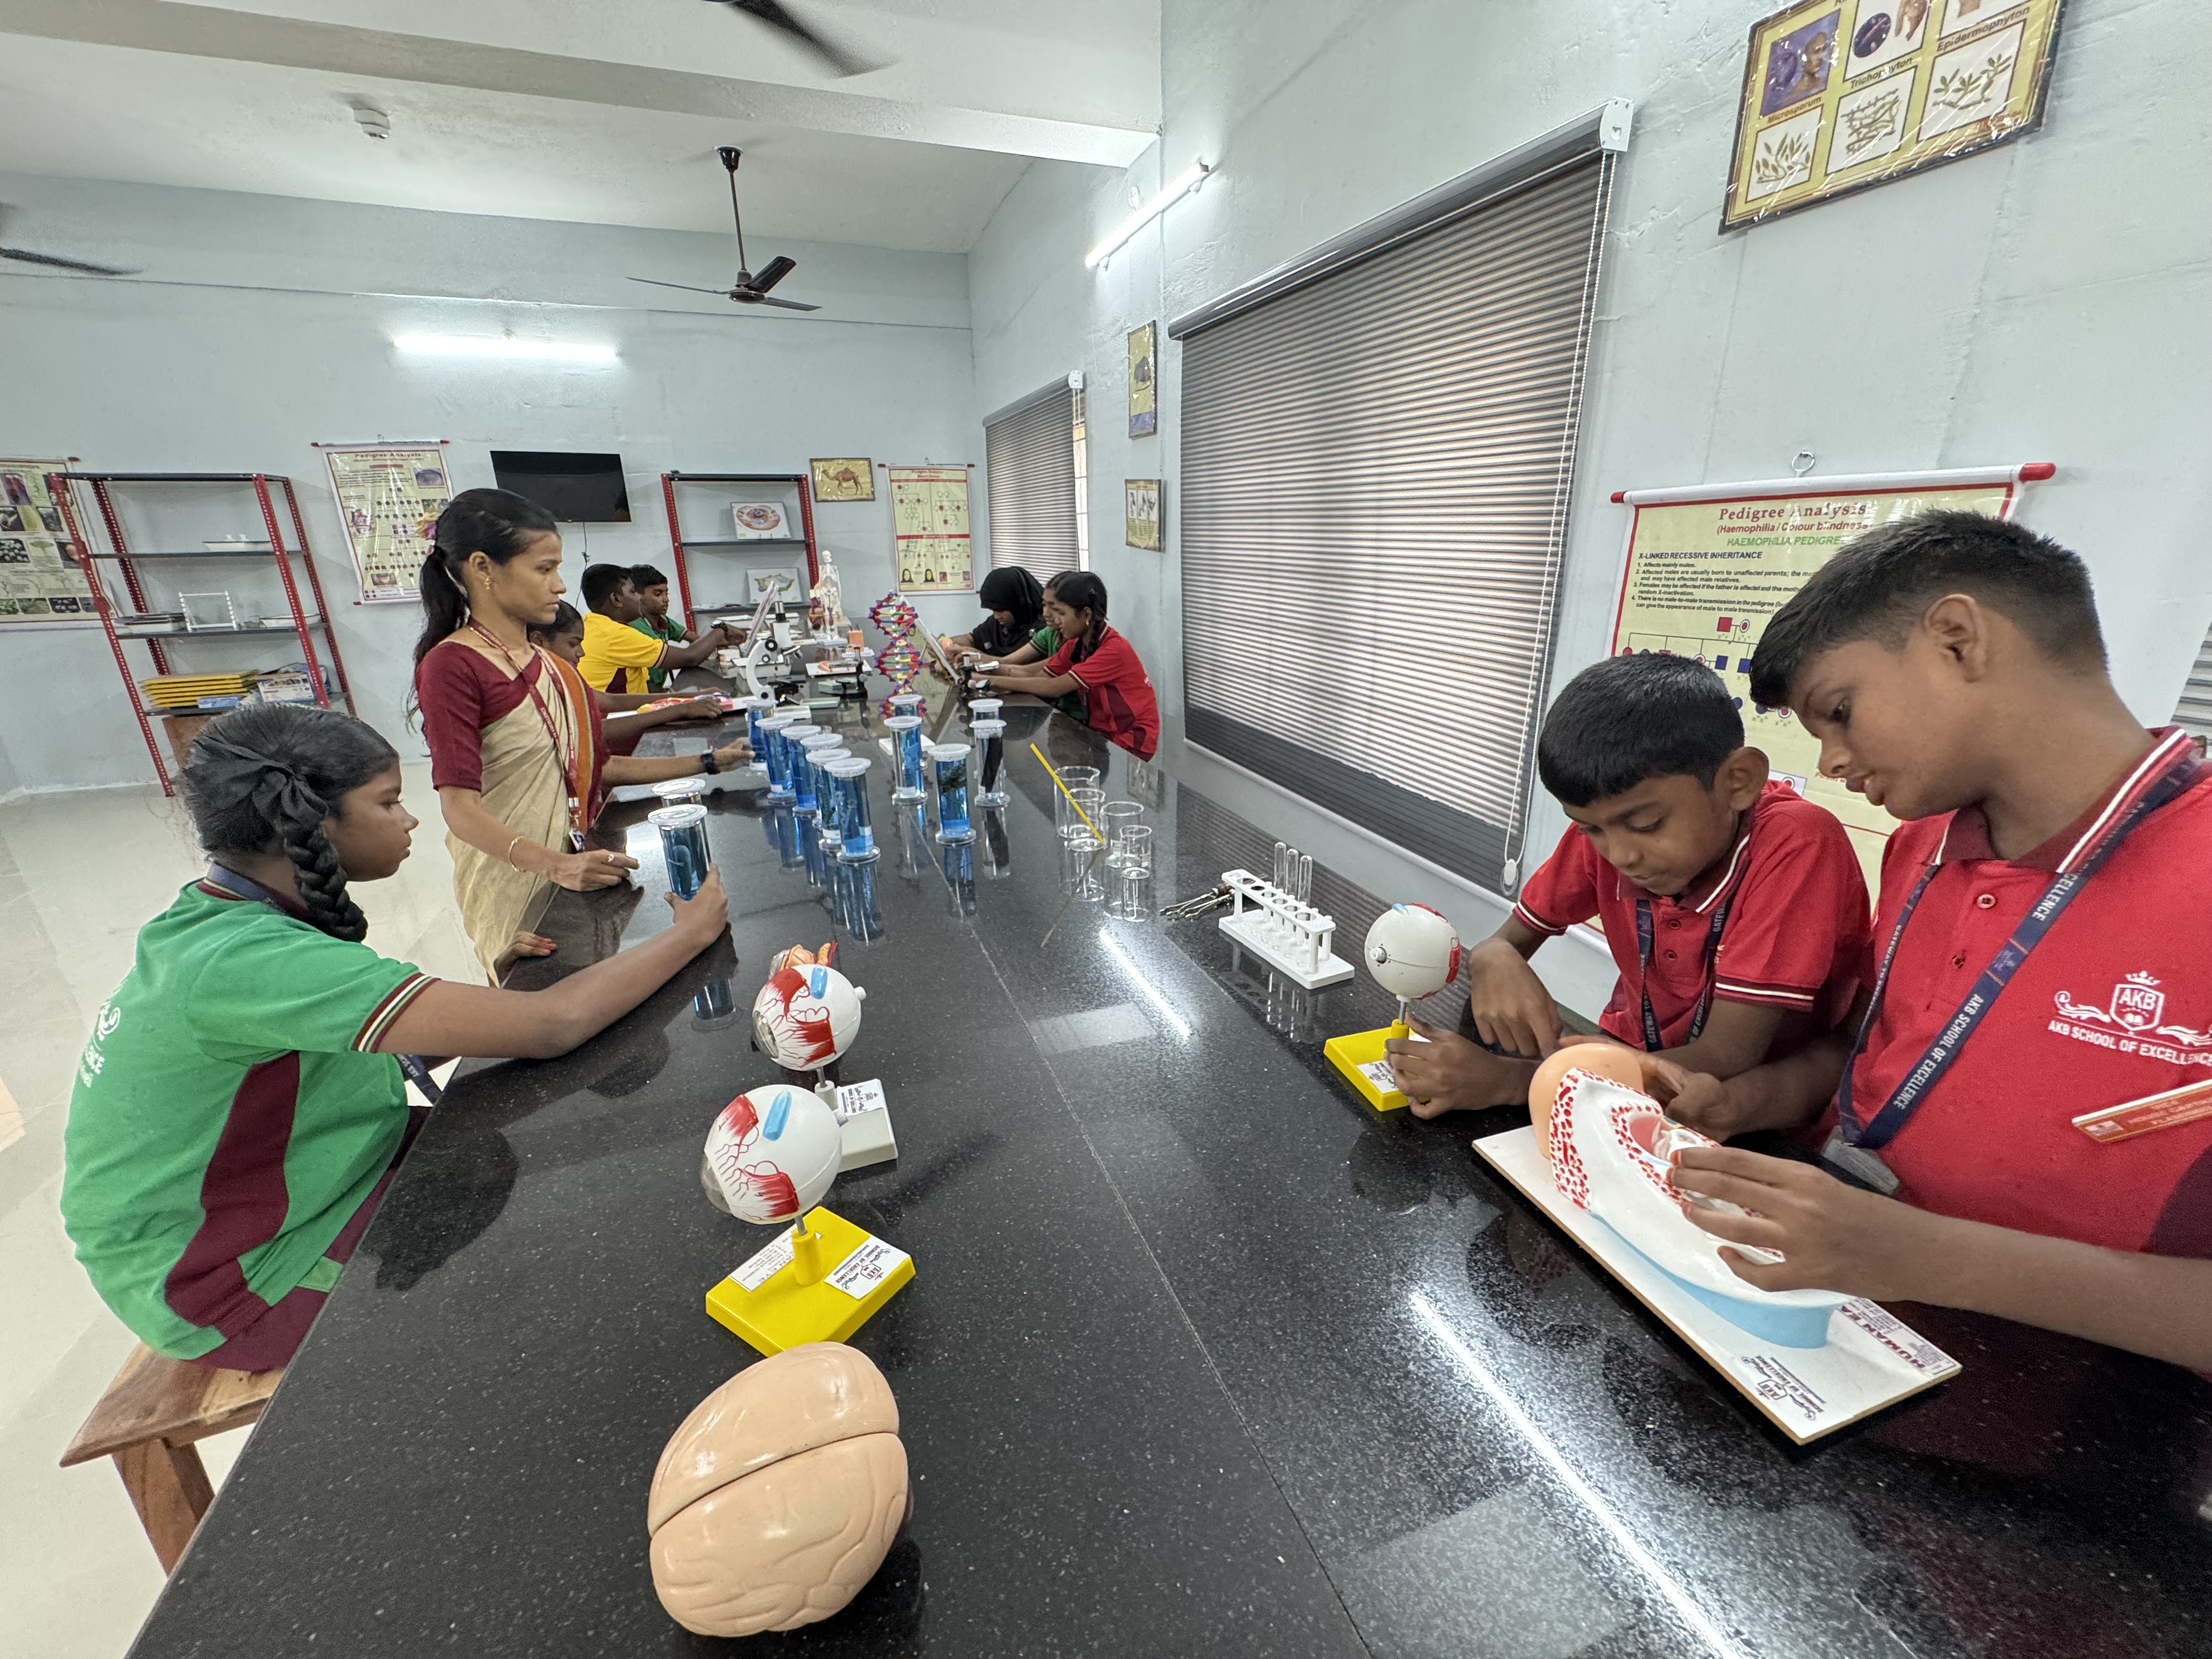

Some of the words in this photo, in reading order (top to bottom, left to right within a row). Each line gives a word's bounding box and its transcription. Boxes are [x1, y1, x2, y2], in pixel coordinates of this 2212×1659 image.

[1768, 97, 1821, 123] Microsporum
[1718, 507, 1785, 522] Pedigree
[1717, 522, 1775, 535] (Haemophilia
[1726, 535, 1793, 546] HAEMOPHILIA
[1793, 536, 1844, 545] PEDIGRE
[2032, 872, 2079, 922] CELLENCE
[1884, 925, 1902, 964] GATEWAY
[1963, 993, 1984, 1015] AKB
[2119, 989, 2157, 1010] AKB
[1939, 1013, 1971, 1048] SCHOOL
[2047, 1020, 2070, 1036] AKB
[2070, 1026, 2117, 1049] SCHOOL
[2119, 1040, 2138, 1053] OF
[1931, 1047, 1947, 1063] OF
[1893, 1059, 1938, 1110] EXCELLENCE
[864, 1245, 880, 1259] SCHOOL
[836, 1262, 860, 1284] EXCELLENCE
[866, 1267, 879, 1279] AKB
[1863, 1324, 1926, 1368] HUMAN
[1755, 1355, 1791, 1385] EXCELLENCE
[1761, 1384, 1780, 1397] AKB
